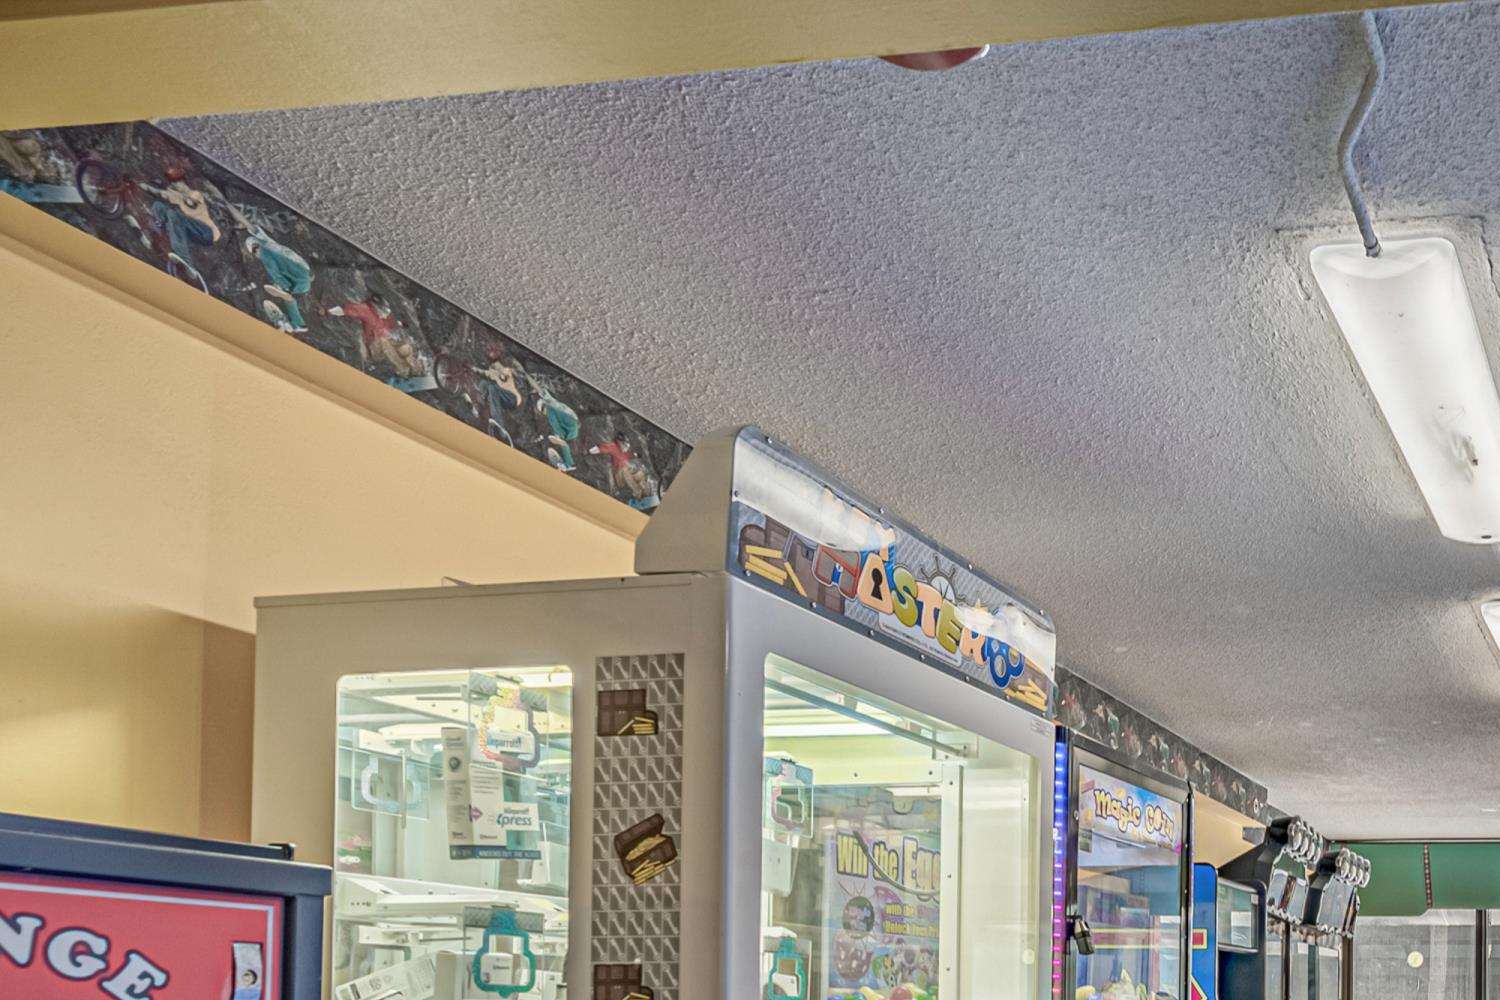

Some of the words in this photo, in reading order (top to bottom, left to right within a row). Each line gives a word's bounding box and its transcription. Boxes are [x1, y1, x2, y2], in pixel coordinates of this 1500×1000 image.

[1094, 789, 1141, 833] Magic
[837, 833, 868, 878] Win
[873, 841, 899, 881] the
